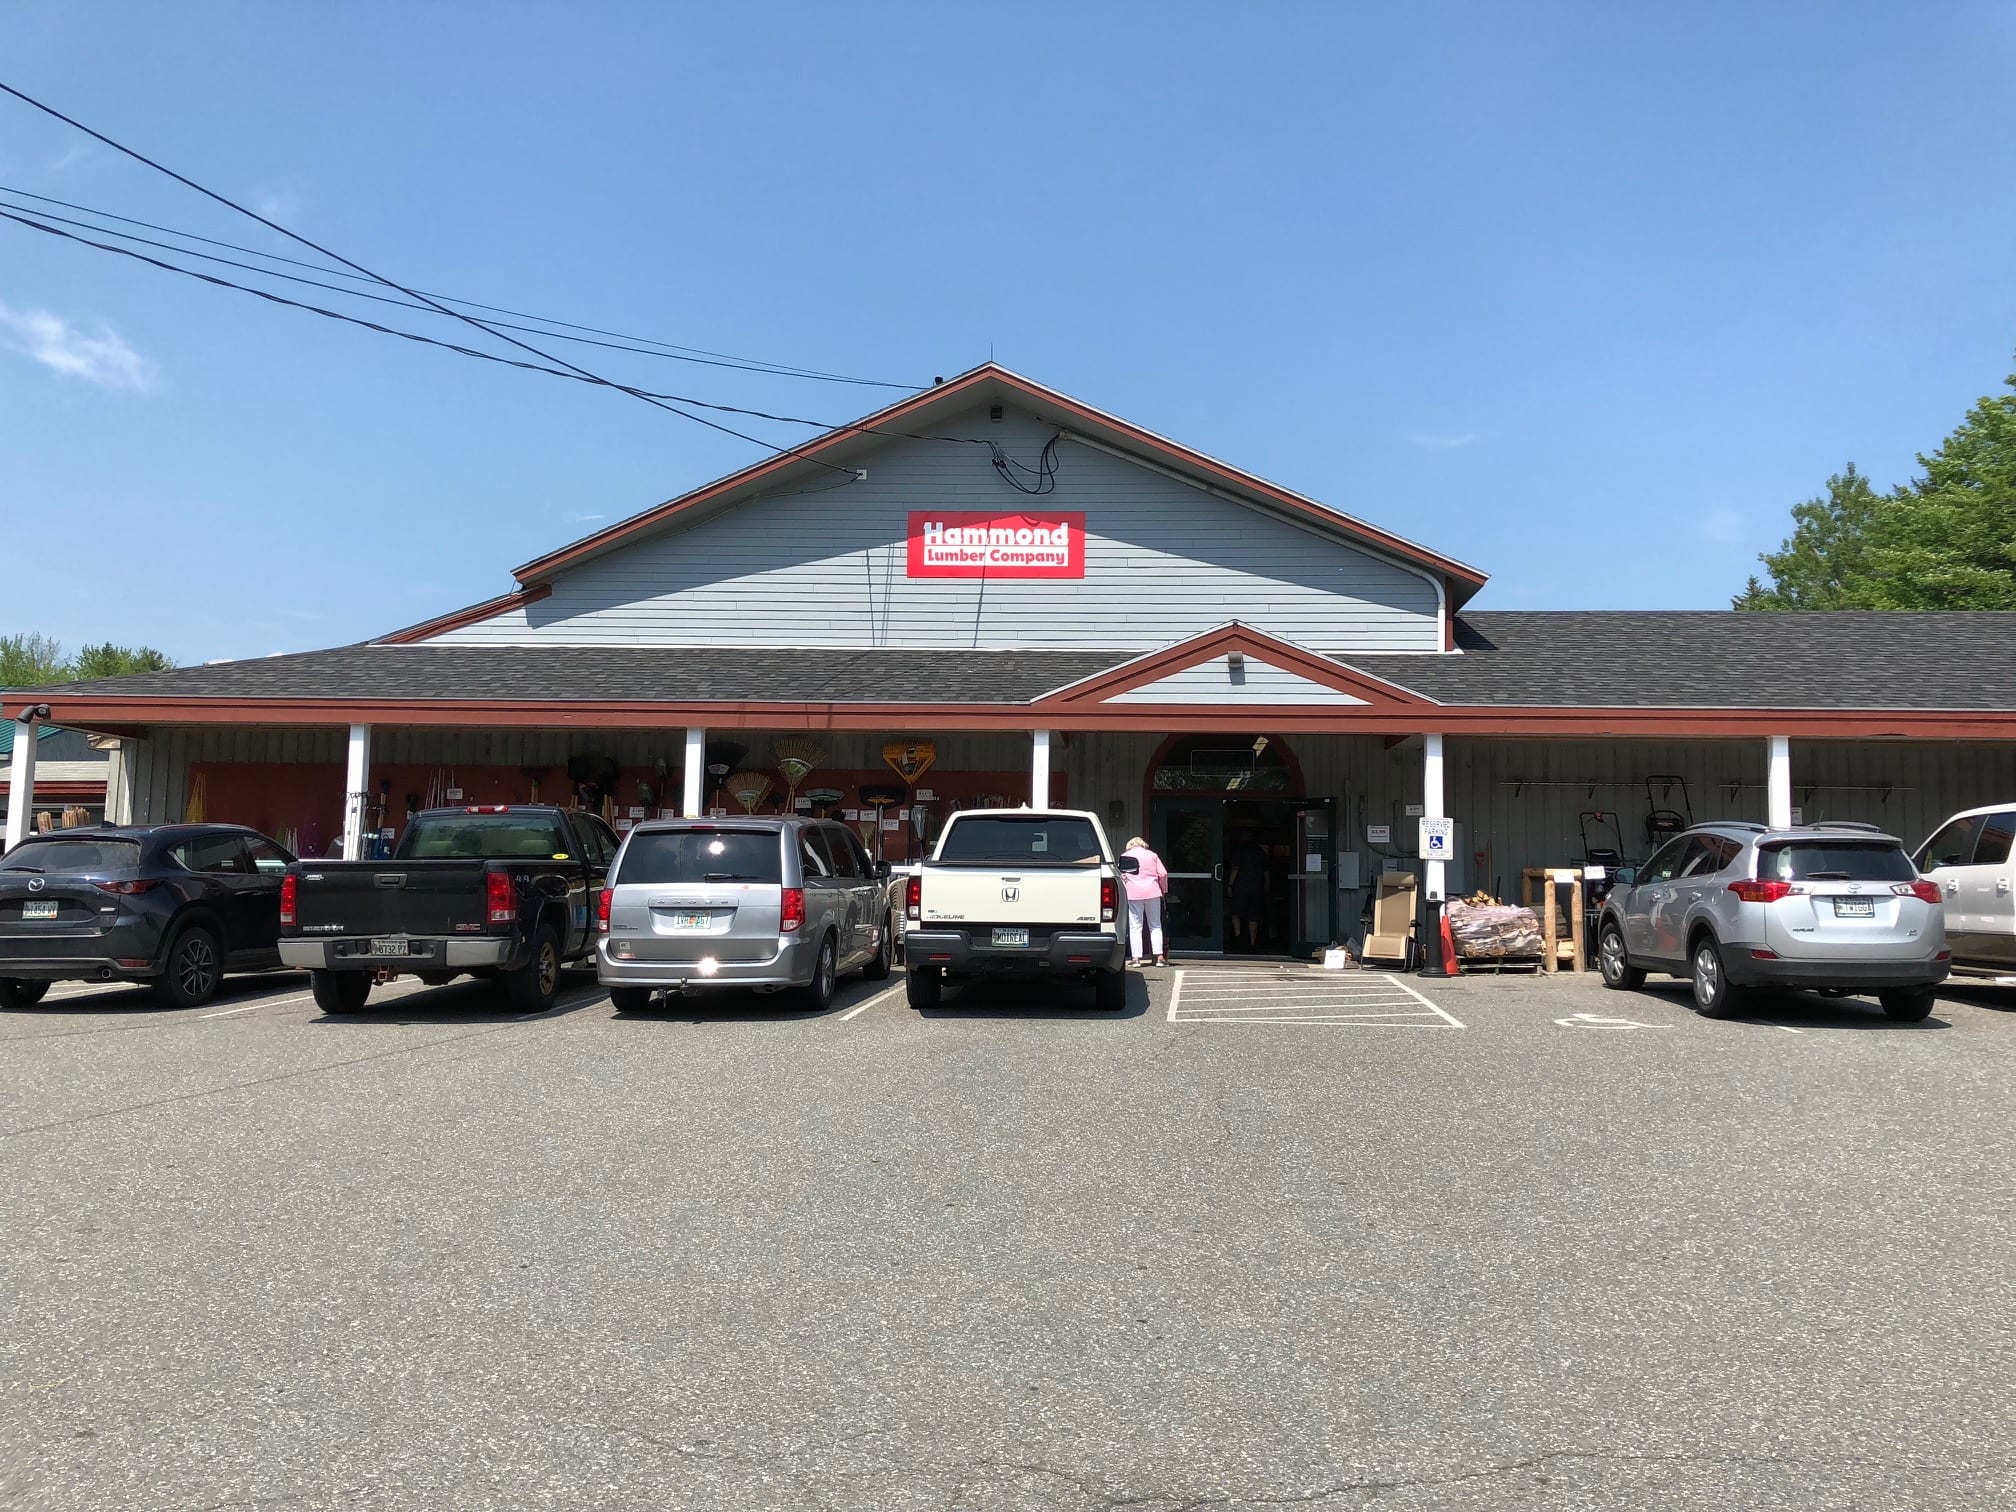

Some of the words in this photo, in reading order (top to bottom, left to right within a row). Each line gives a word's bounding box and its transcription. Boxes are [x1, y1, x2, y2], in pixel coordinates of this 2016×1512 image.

[923, 522, 1069, 546] Hammond
[927, 549, 986, 562] Lumber
[990, 549, 1065, 565] Company
[1421, 820, 1450, 828] RESERVED
[1424, 828, 1449, 836] PARKING
